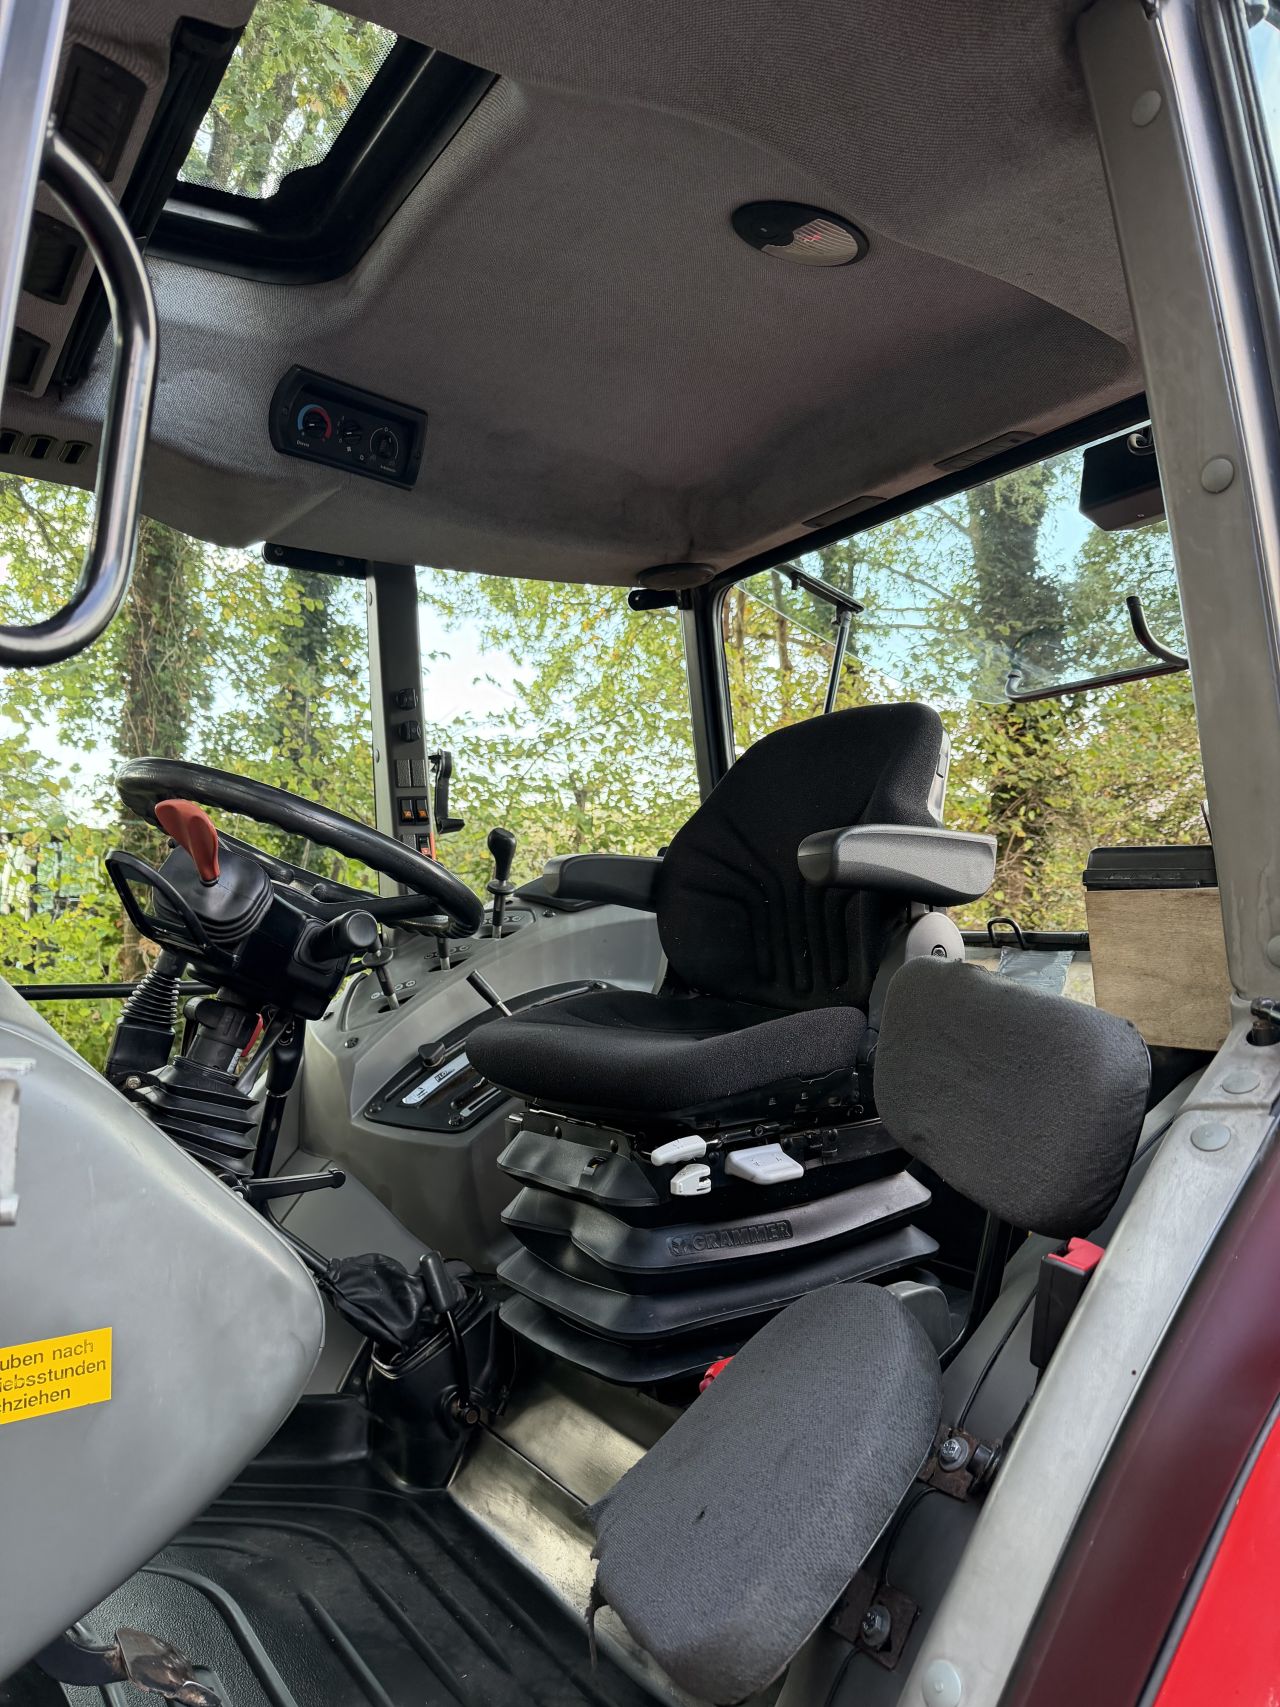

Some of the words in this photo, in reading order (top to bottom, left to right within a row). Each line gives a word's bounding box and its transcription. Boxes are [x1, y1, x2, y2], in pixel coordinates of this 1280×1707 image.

[692, 1221, 792, 1251] GRAMMER
[0, 1352, 44, 1371] uben
[52, 1339, 94, 1360] nach
[0, 1388, 71, 1413] hziehen
